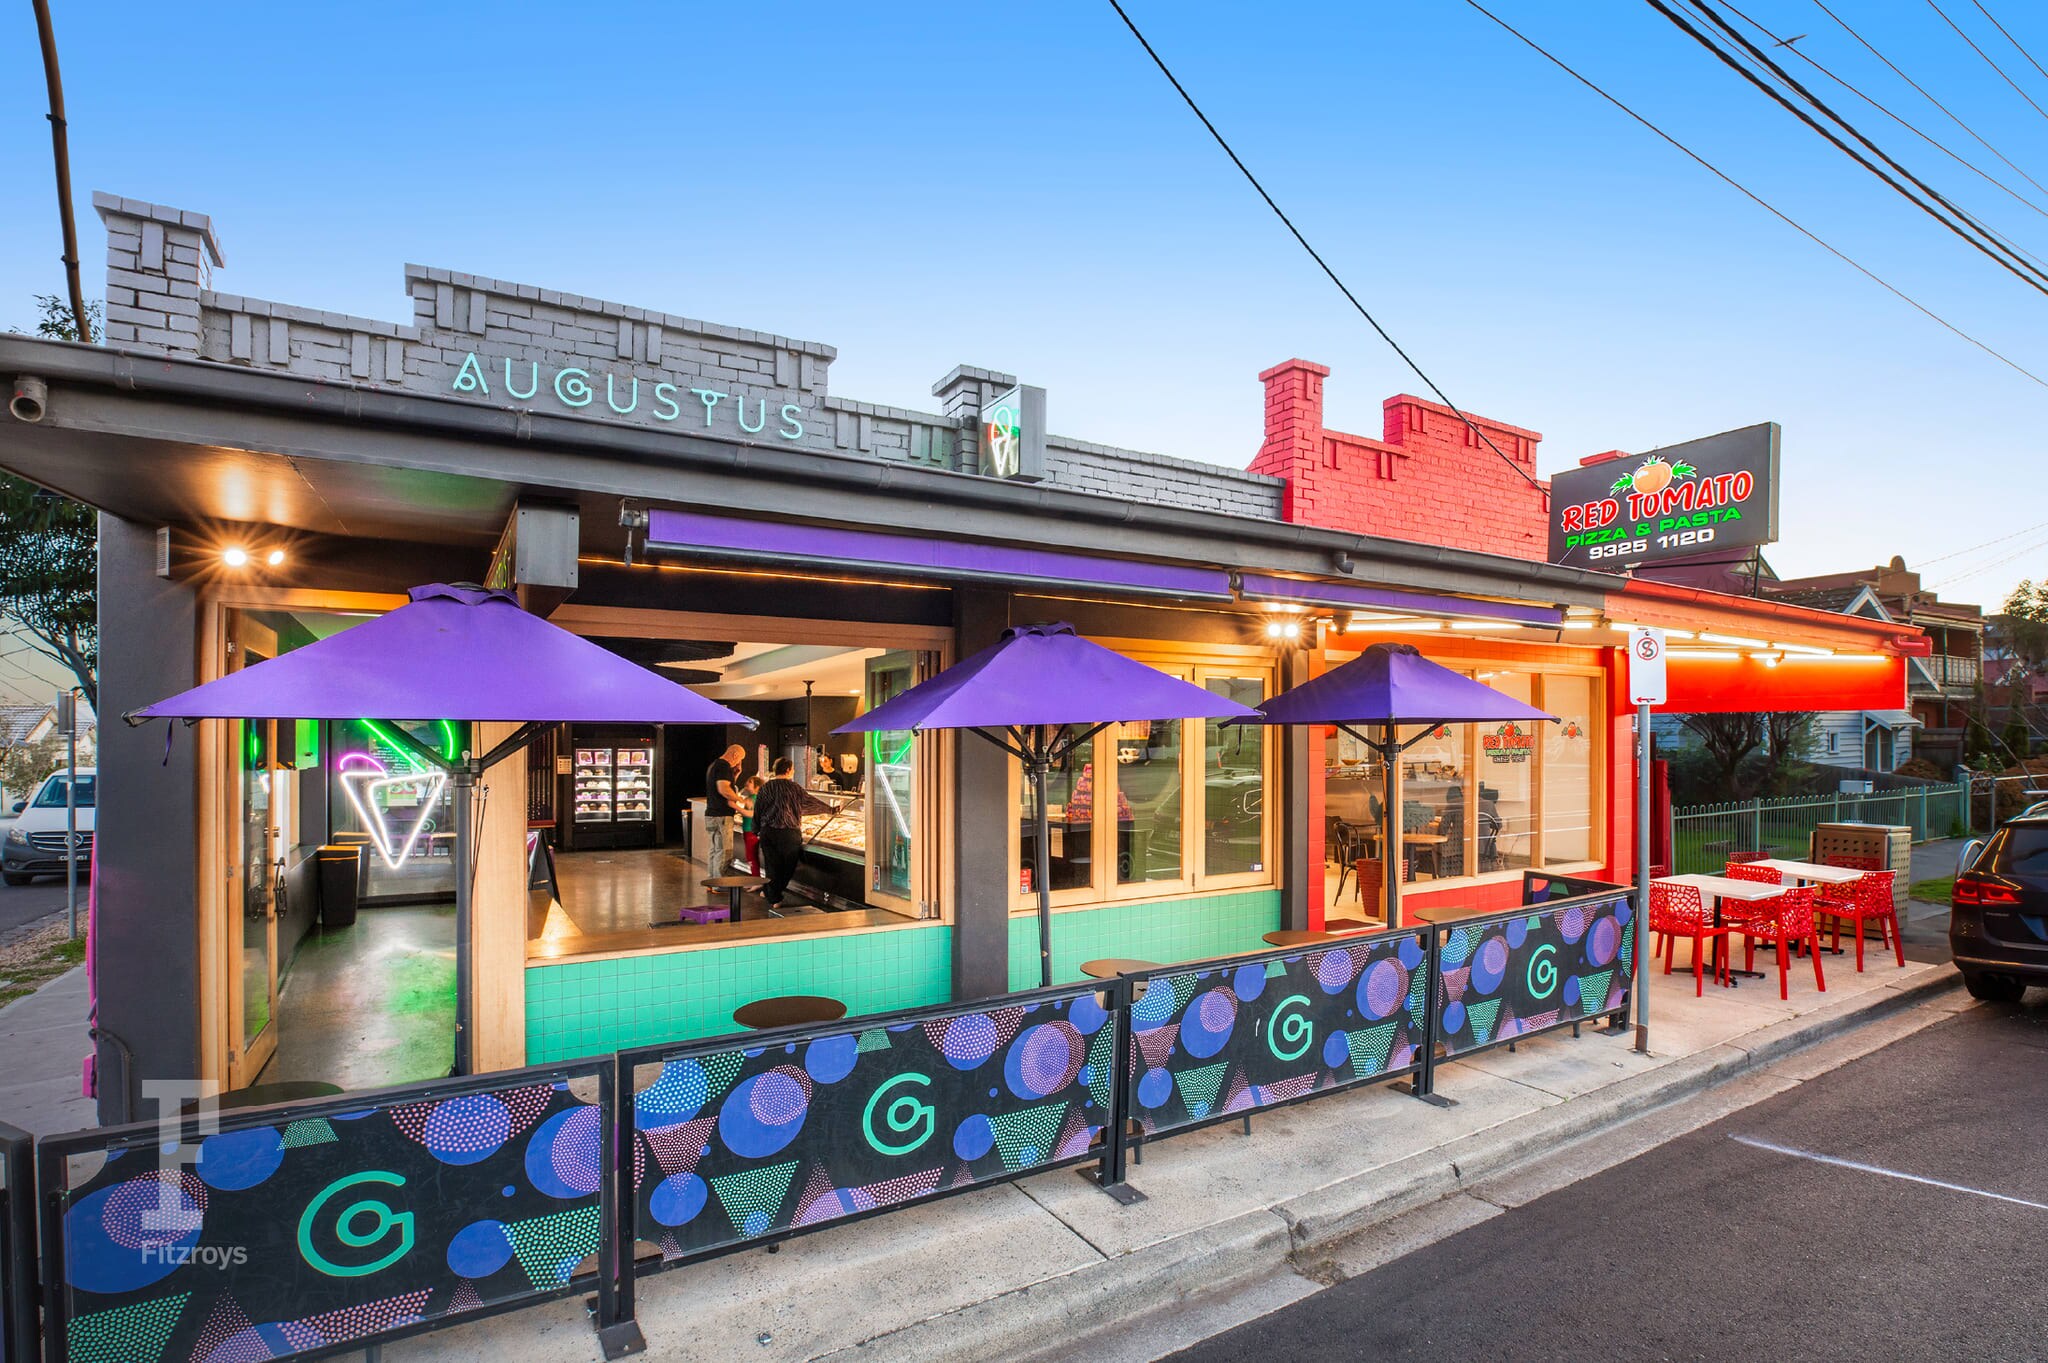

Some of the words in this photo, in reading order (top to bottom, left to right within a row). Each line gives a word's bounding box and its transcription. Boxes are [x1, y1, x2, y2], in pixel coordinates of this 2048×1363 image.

[453, 352, 803, 440] AUGUSTUS
[1561, 497, 1619, 533] RED
[1627, 470, 1754, 522] TOMATO
[1566, 527, 1628, 549] PIZZA
[1635, 523, 1651, 538] &
[1659, 507, 1742, 533] PASTA
[1589, 539, 1648, 560] 9325
[1657, 528, 1715, 549] 1120
